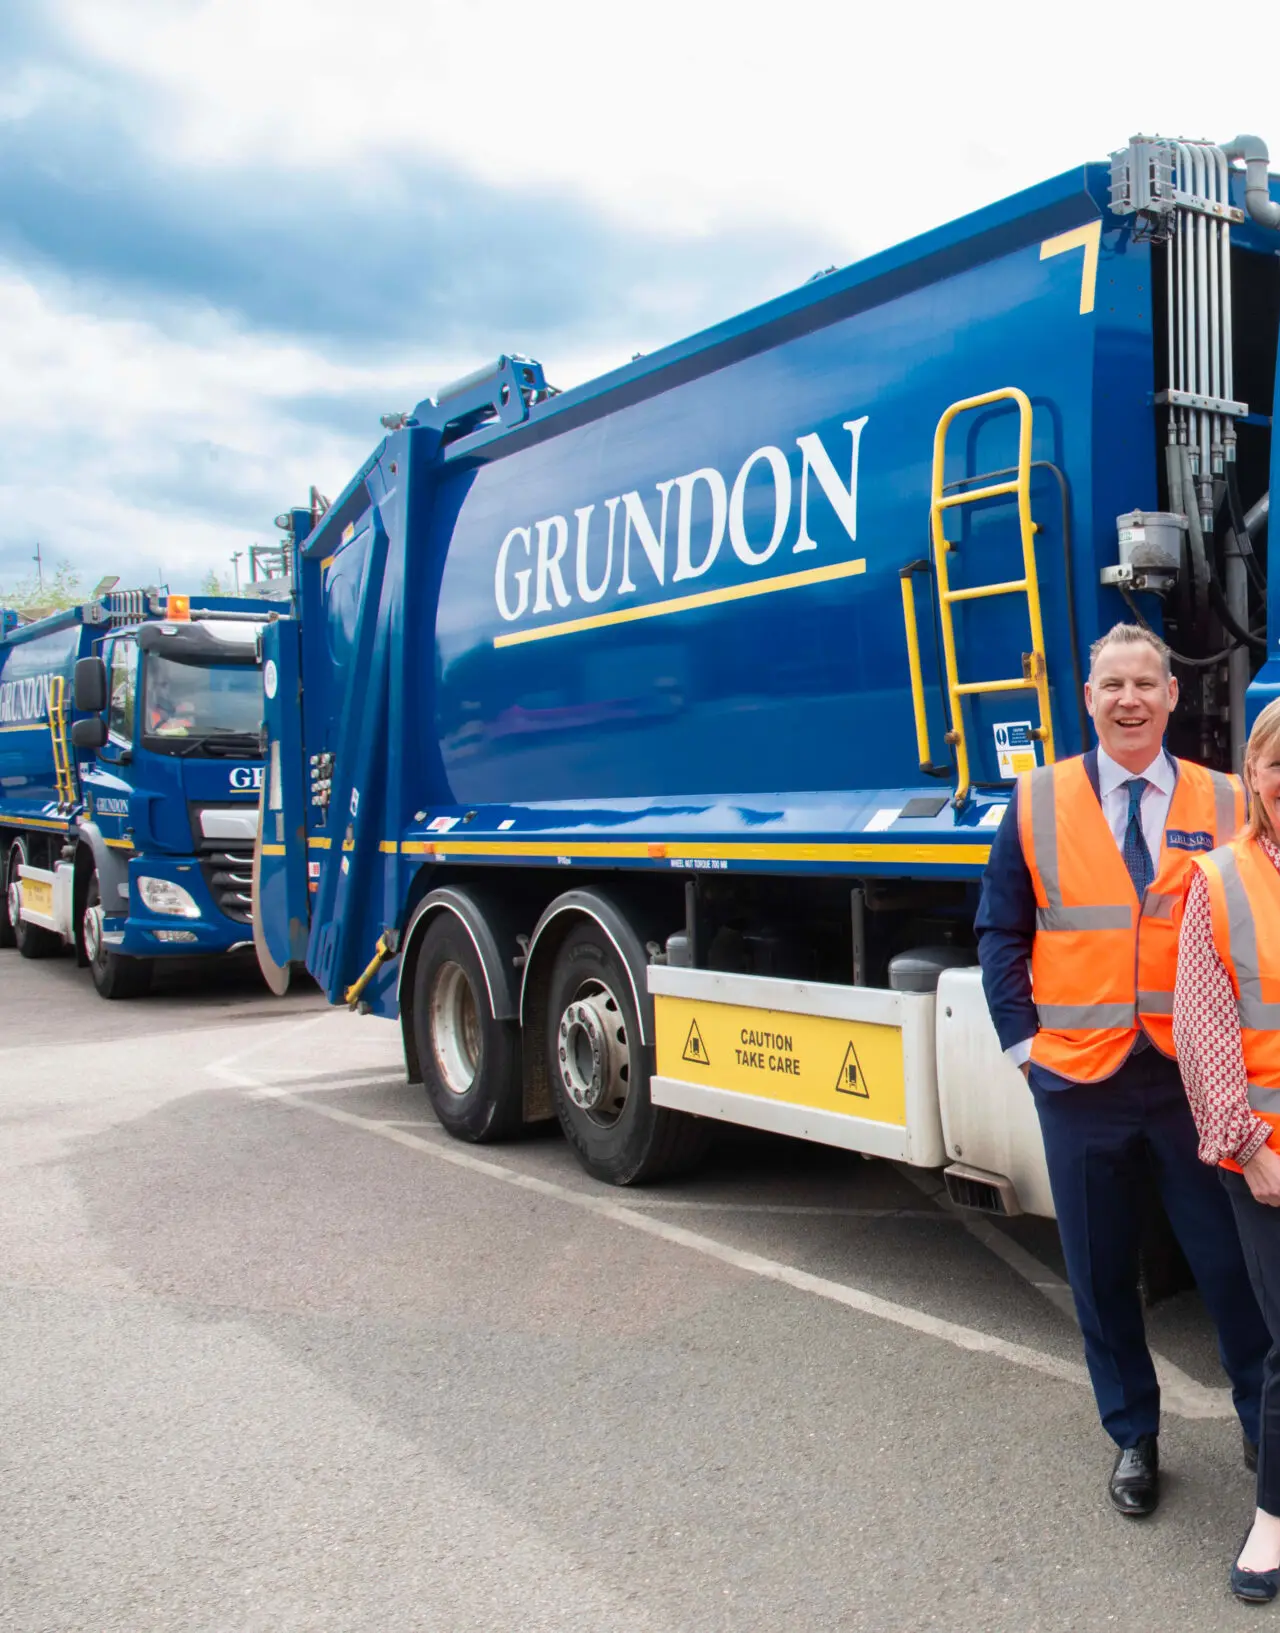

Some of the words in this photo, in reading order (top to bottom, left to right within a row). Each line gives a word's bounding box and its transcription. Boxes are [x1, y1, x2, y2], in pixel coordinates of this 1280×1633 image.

[495, 416, 869, 621] GRUNDON
[740, 1028, 793, 1052] CAUTION
[735, 1049, 765, 1069] TAKE
[768, 1055, 801, 1075] CARE
